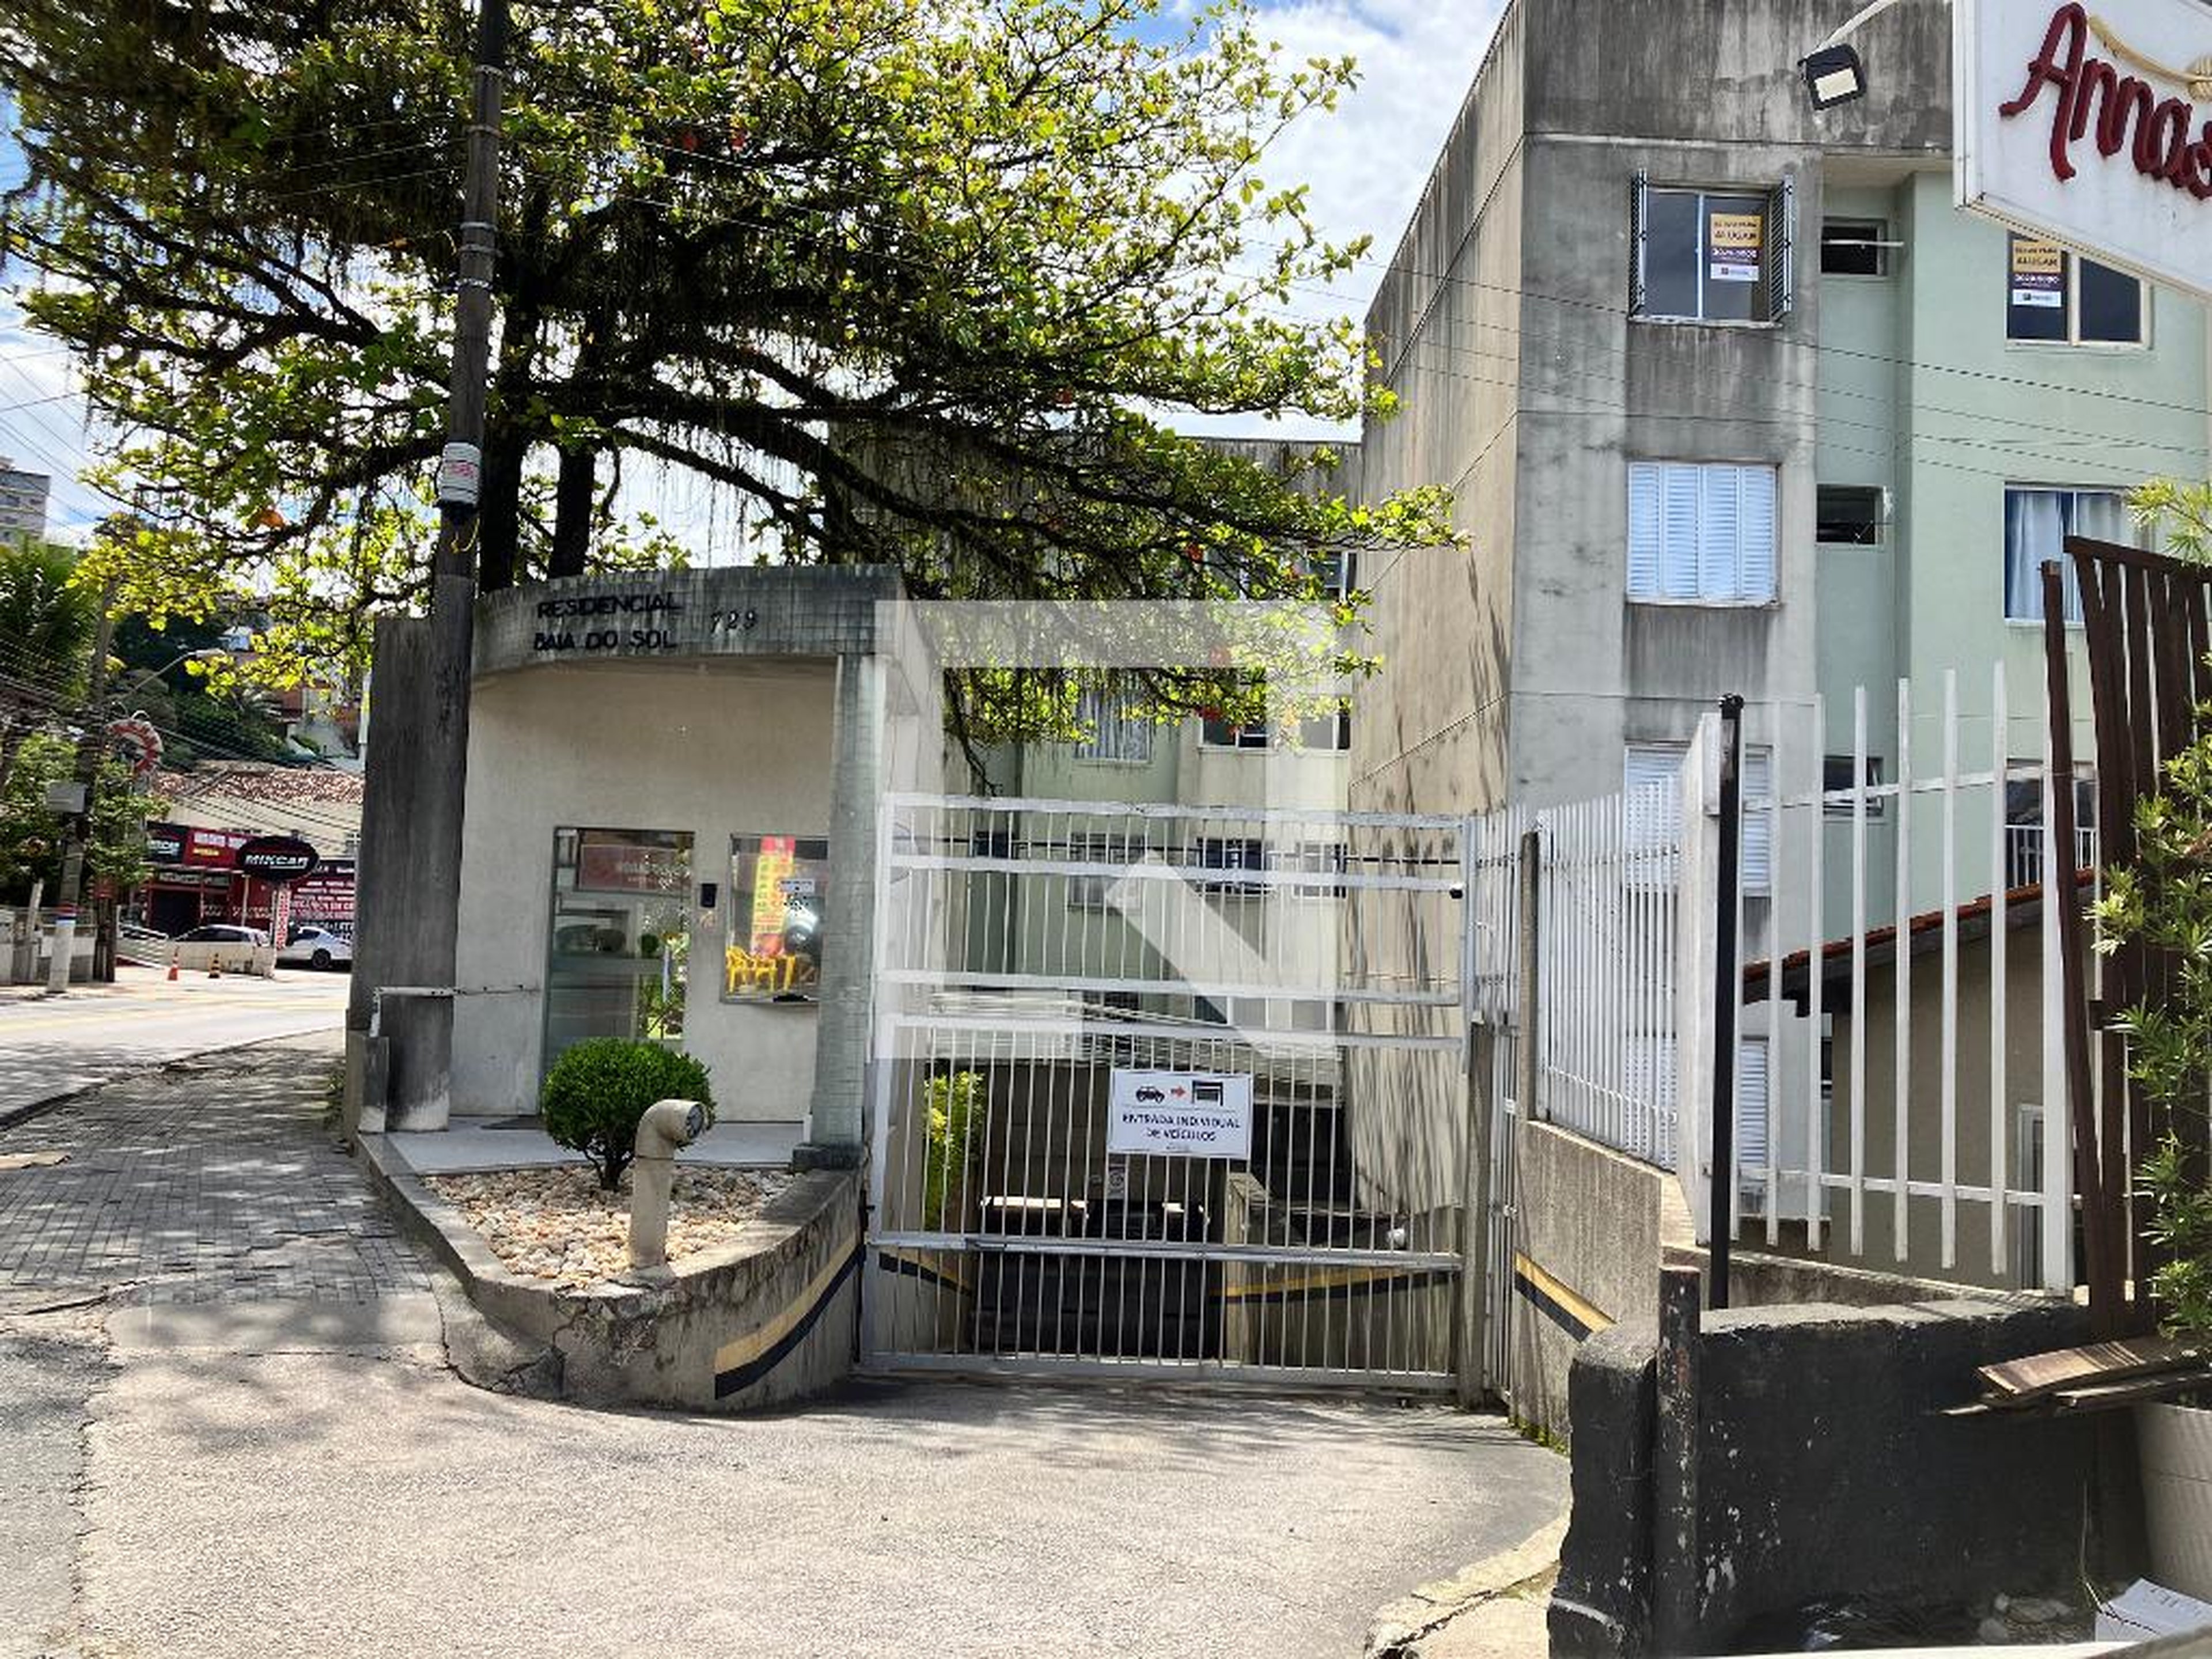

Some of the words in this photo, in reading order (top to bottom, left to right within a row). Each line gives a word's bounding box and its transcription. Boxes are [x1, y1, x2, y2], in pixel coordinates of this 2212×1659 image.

[537, 592, 683, 619] RESIDENCIAL
[710, 609, 759, 633] 729
[585, 630, 619, 649] DO
[629, 630, 678, 650] SOL
[1122, 1113, 1174, 1124] ENTRADA
[1176, 1115, 1241, 1128] INDIVIDUAL
[1146, 1127, 1161, 1139] DE
